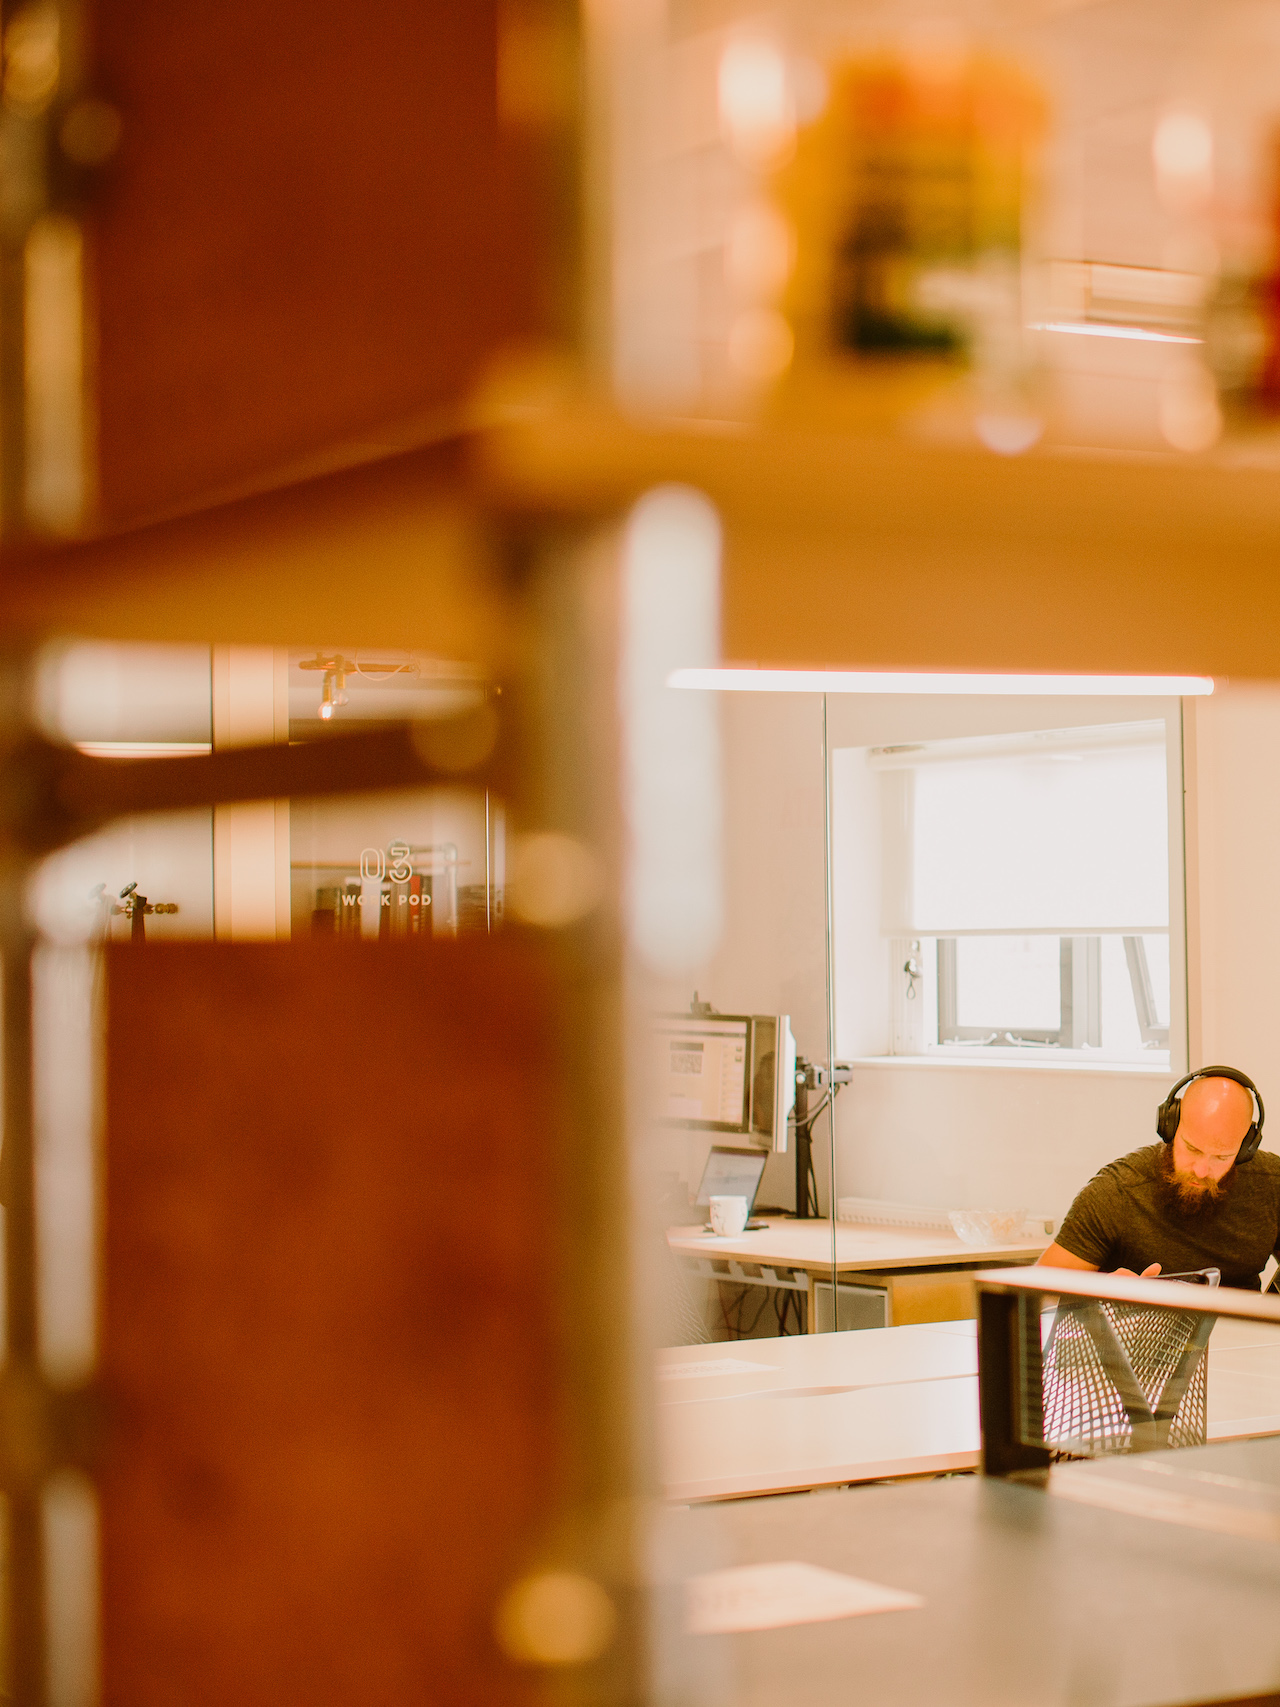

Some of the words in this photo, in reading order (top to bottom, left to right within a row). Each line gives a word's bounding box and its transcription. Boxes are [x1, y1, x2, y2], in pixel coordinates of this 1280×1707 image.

[359, 847, 413, 884] 03
[342, 894, 390, 907] WORK
[398, 894, 432, 906] POD
